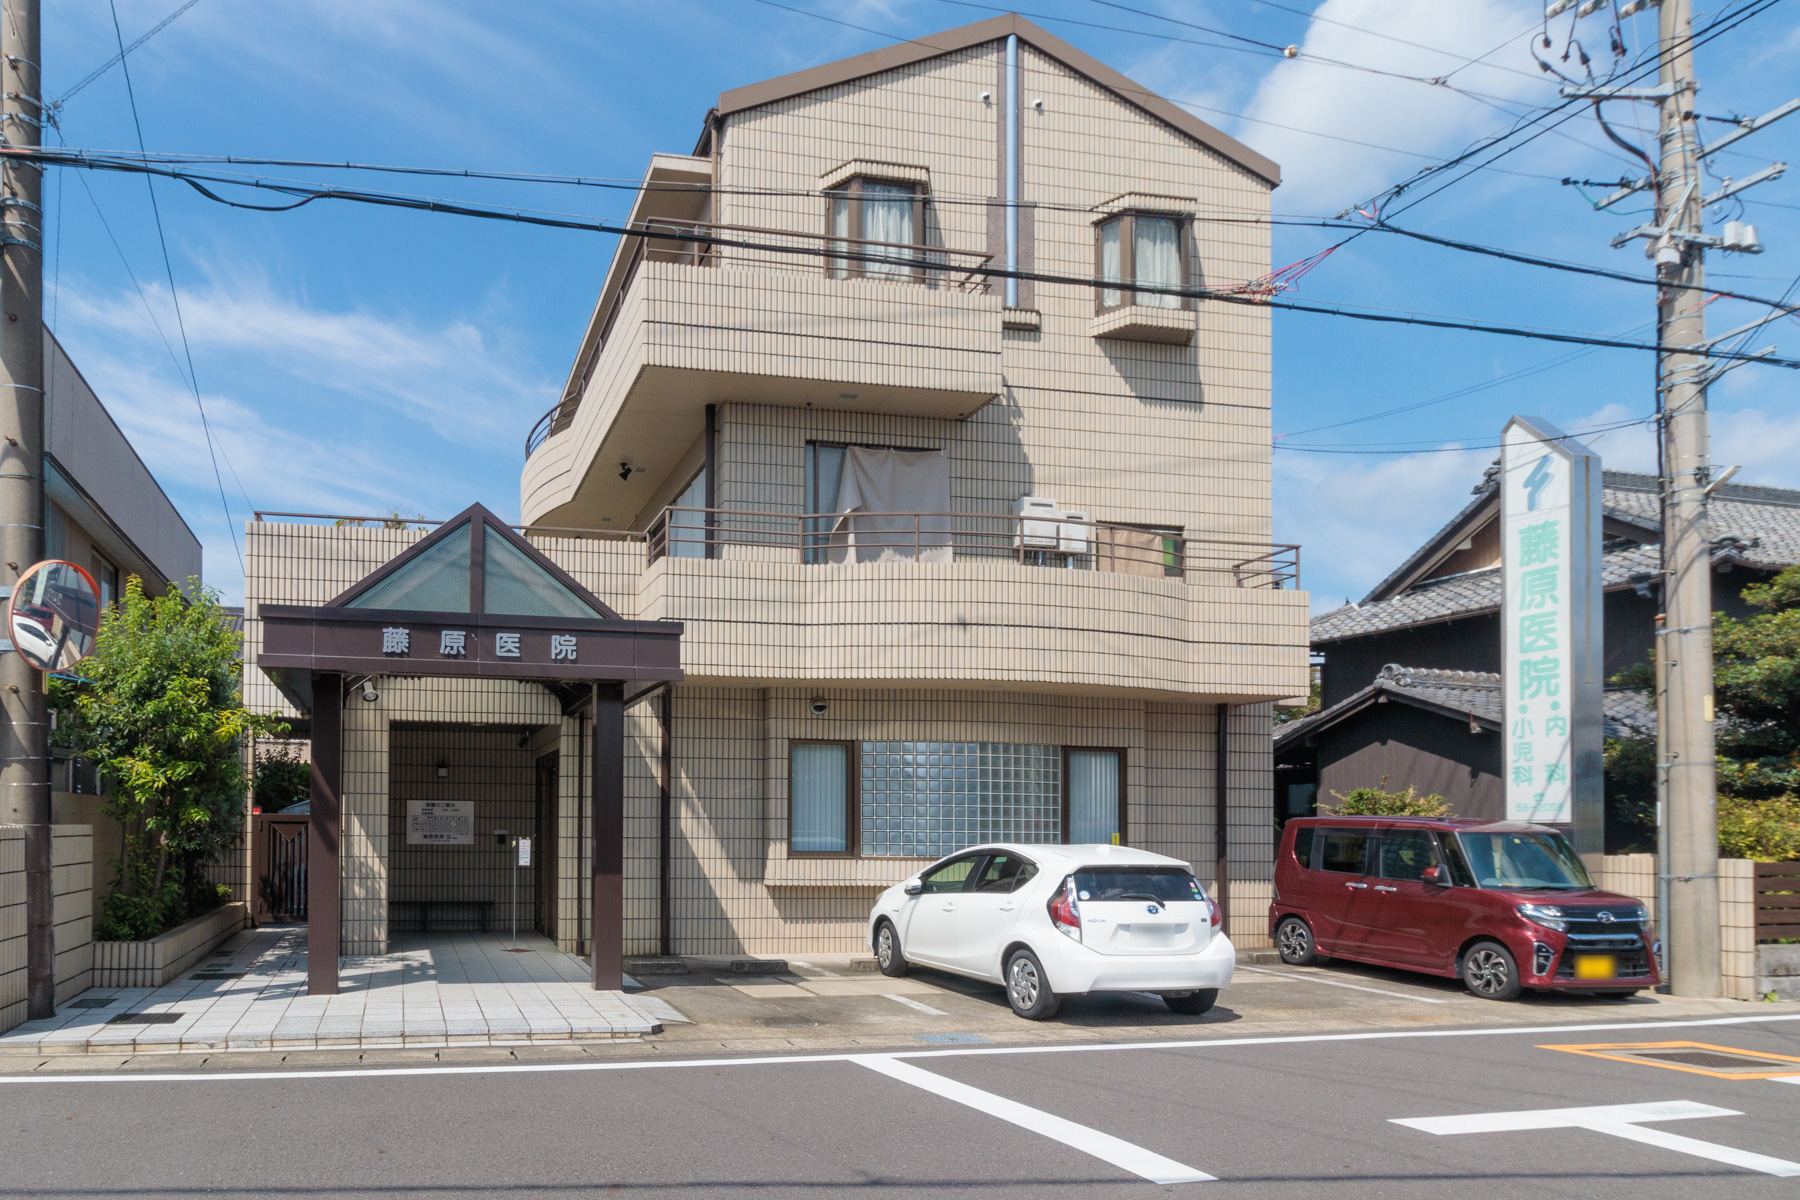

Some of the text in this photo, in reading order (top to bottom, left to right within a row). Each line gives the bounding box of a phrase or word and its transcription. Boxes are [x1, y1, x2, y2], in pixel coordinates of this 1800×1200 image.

[382, 627, 577, 660] 藤原医院
[1518, 519, 1561, 701] 藤原医院
[1512, 717, 1534, 788] 小児科
[1545, 715, 1568, 786] 内科
